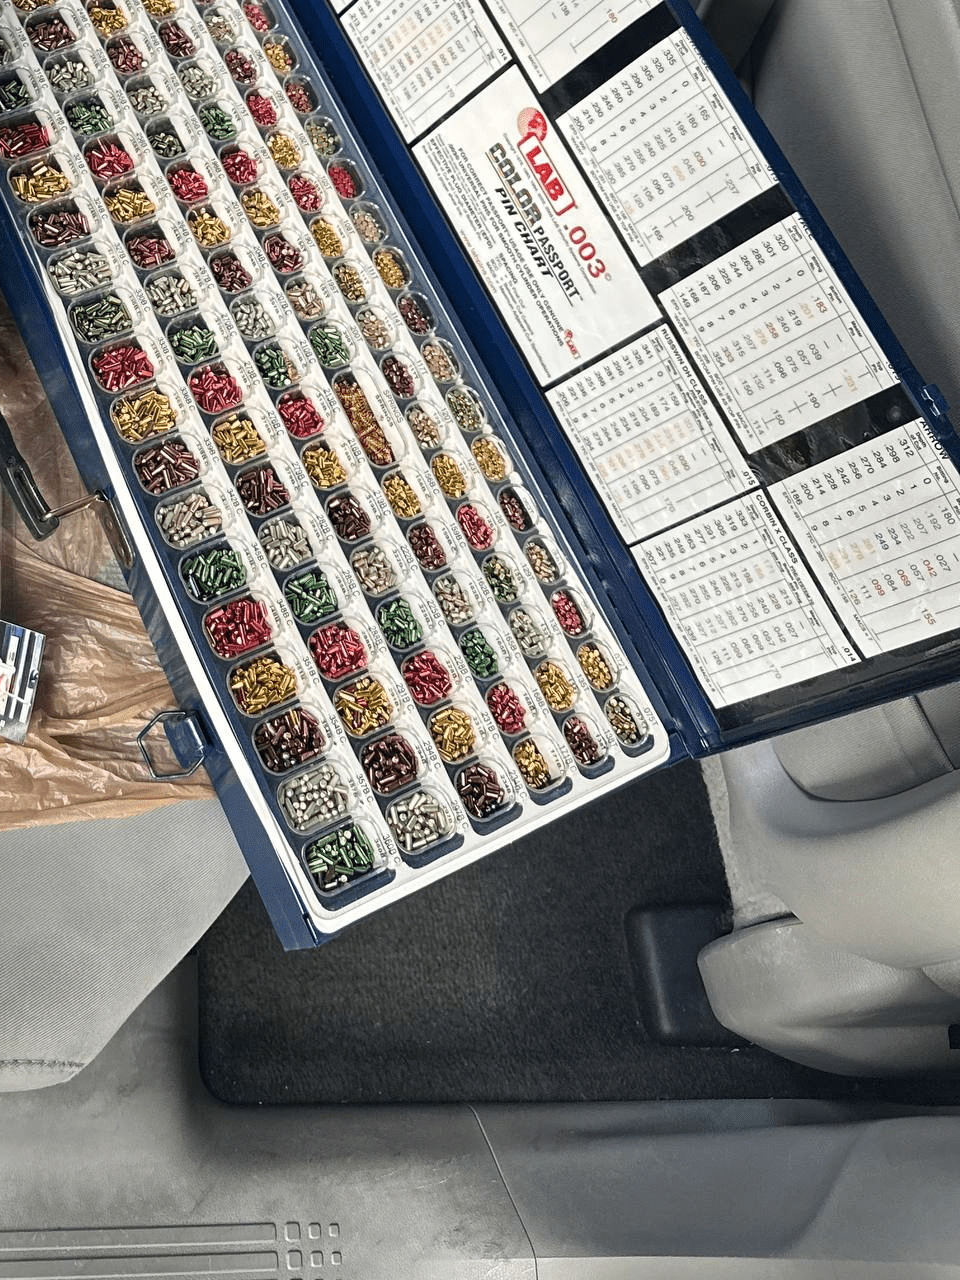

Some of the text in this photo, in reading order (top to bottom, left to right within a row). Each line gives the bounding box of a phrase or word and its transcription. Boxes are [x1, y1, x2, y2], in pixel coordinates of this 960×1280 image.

[650, 55, 664, 74] .320
[683, 111, 698, 129] .180
[661, 47, 676, 66] .335
[695, 102, 710, 121] .165
[427, 137, 494, 249] EFFECTIVE PLUG DIAMETER (EPD)
[484, 141, 546, 227] COLOR
[524, 145, 567, 202] LAB
[456, 147, 469, 163] FOR
[464, 163, 488, 197] CORRECT
[507, 238, 525, 263] USAGE
[522, 263, 534, 279] USE
[531, 279, 545, 299] ONLY
[541, 299, 564, 332] GENUINE
[456, 161, 565, 347] UNIVERSAL PINS FOR SMOOTH CYLINDER OPERATIONS
[493, 184, 555, 282] PIN CHART
[496, 252, 519, 284] SPACING
[738, 252, 753, 272] .263
[761, 239, 777, 258] .301
[773, 231, 789, 252] .320
[810, 293, 827, 314] .183
[659, 328, 708, 405] RUSSWIN DH CLASS
[772, 359, 787, 379] .096
[804, 388, 820, 409] .190
[380, 388, 405, 423] SPRINGS
[740, 467, 755, 486] .015
[871, 448, 951, 574] .284 .027
[884, 442, 941, 531] .298 .192
[897, 436, 914, 458] .312
[938, 503, 955, 526] .180
[754, 493, 777, 527] CORBIN
[777, 534, 799, 564] CLASS
[834, 464, 850, 485] .242
[873, 530, 889, 551] .249
[895, 566, 911, 587] .069
[841, 644, 856, 662] .014
